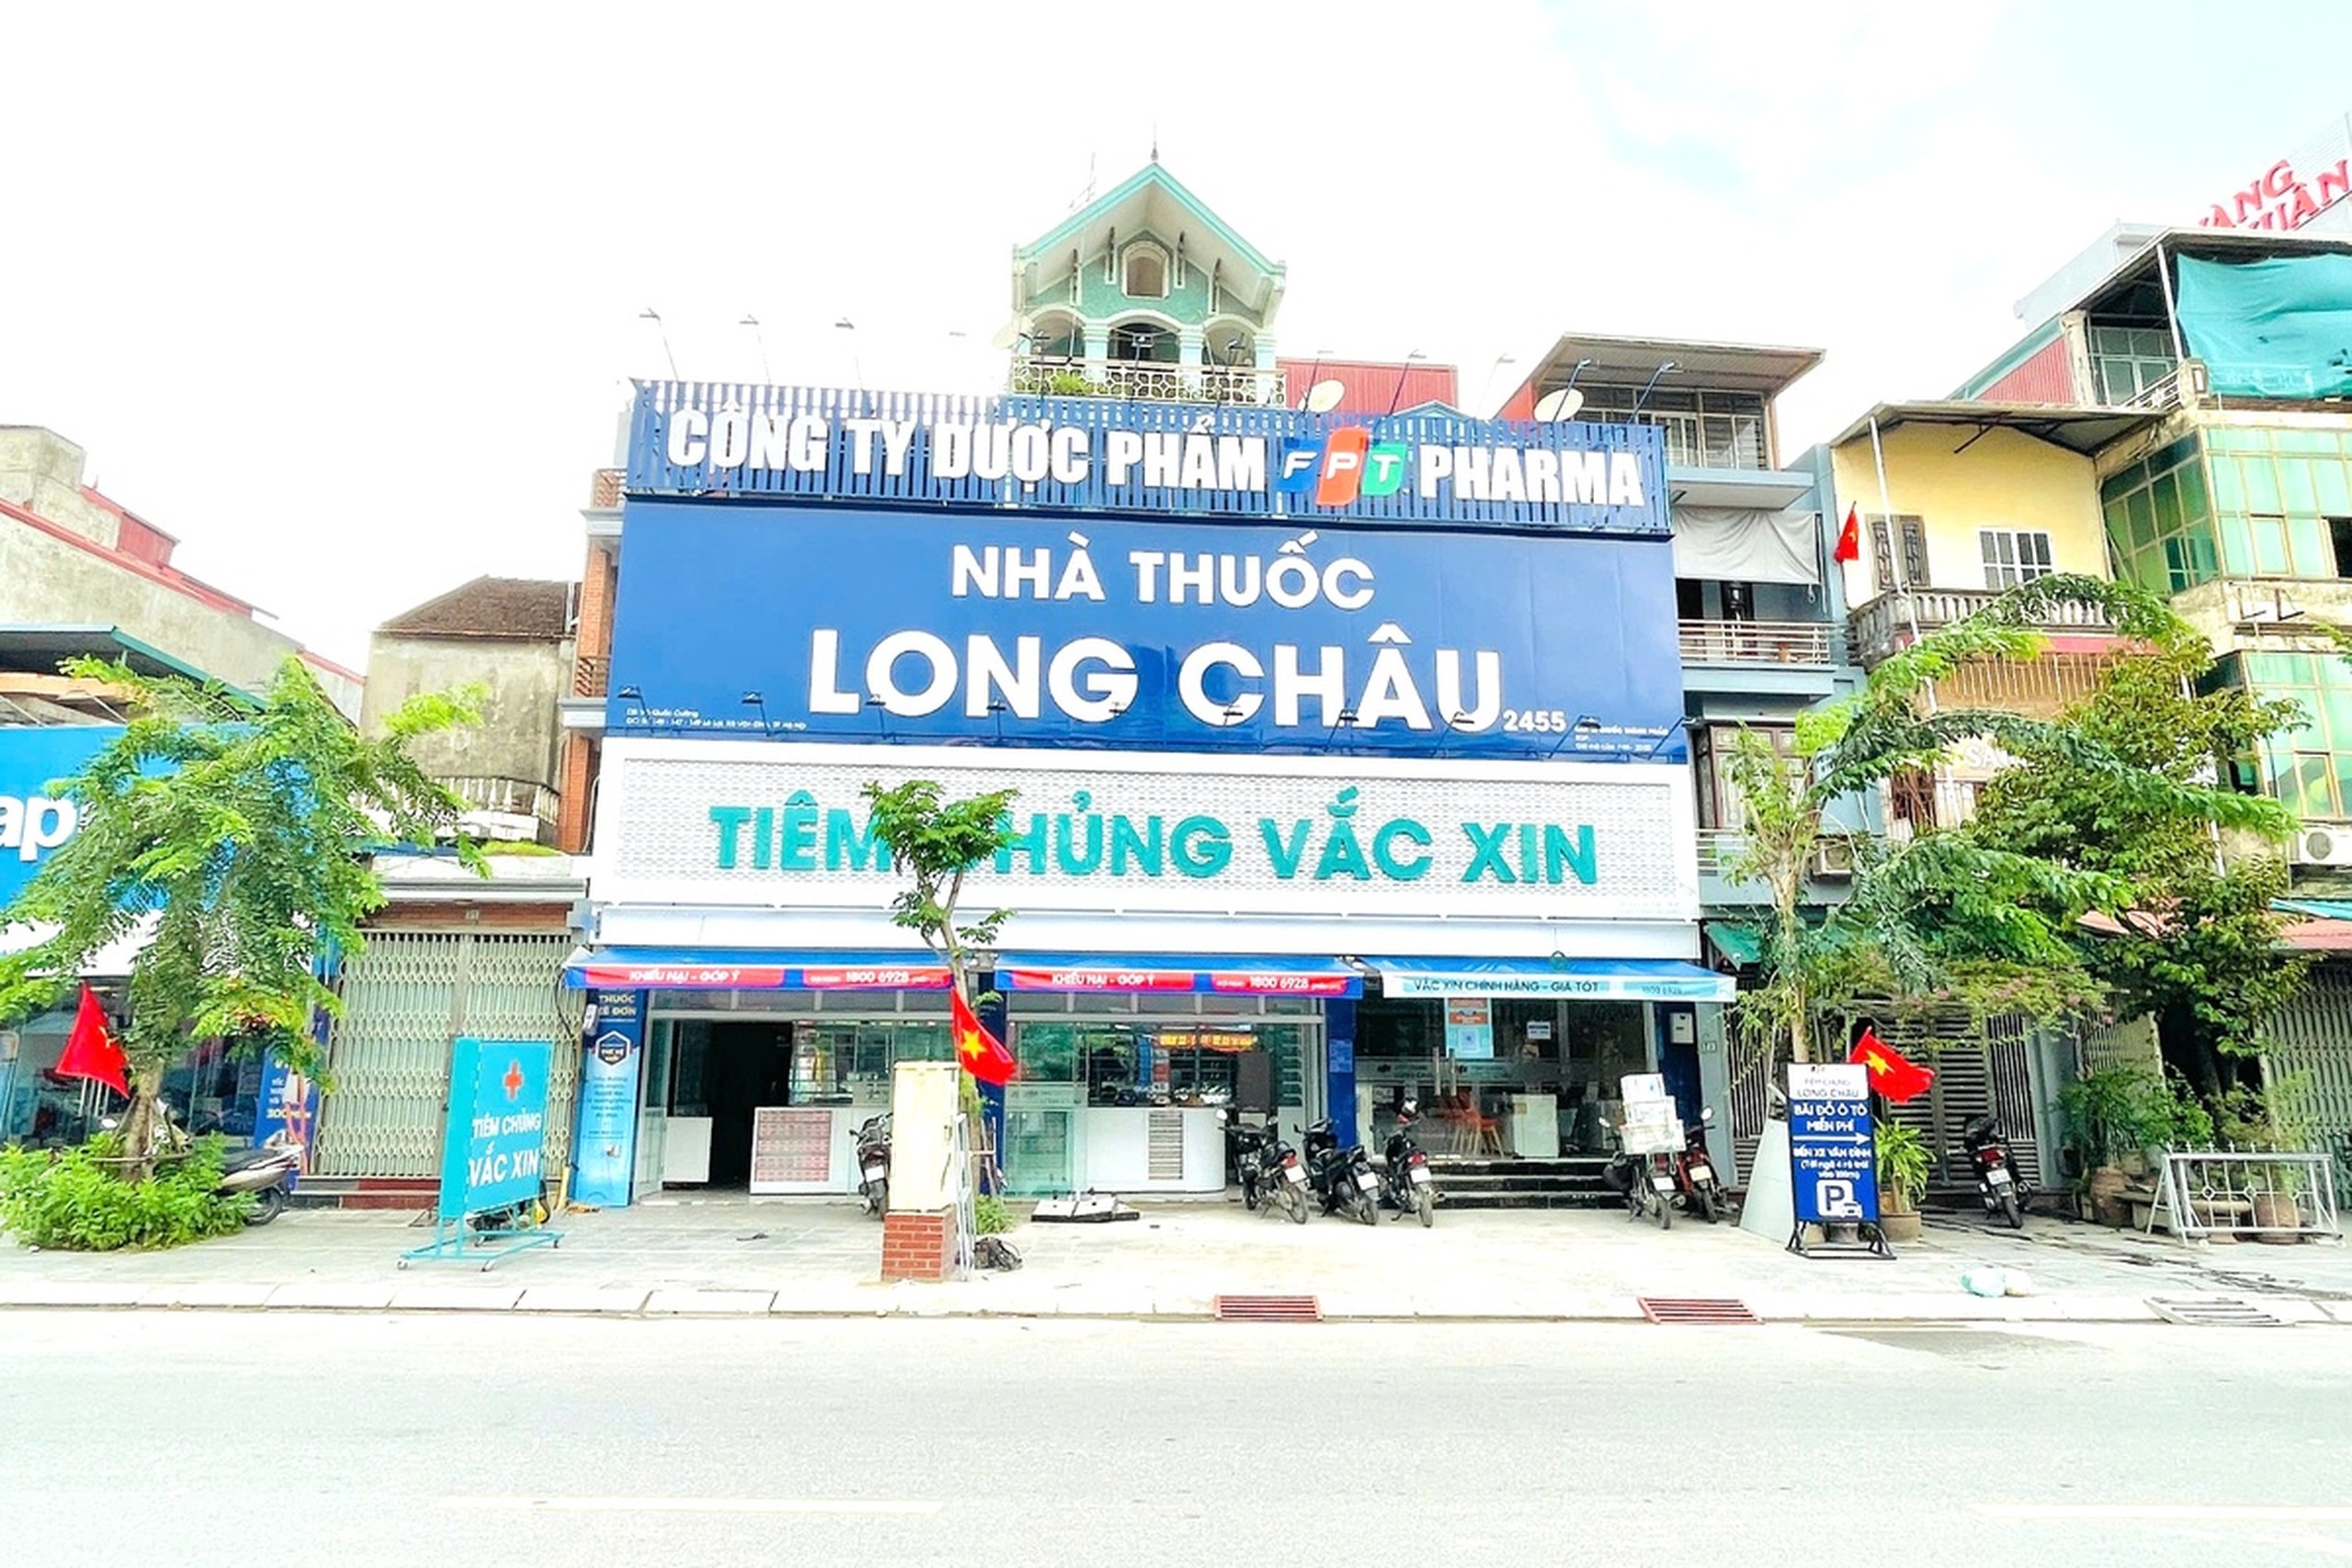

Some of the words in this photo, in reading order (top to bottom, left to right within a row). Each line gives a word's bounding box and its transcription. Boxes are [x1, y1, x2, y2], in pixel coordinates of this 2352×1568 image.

[667, 400, 829, 469] CÔNG
[843, 417, 916, 476] TY
[933, 412, 1091, 492] DƯỢC
[1107, 412, 1266, 492] PHẨM
[1419, 444, 1645, 508] PHARMA
[952, 530, 1106, 602] NHÀ
[1128, 529, 1375, 611] THUỐC
[808, 628, 1139, 724] LONG
[1177, 623, 1503, 733] CHÂU
[1502, 709, 1567, 734] 2455
[708, 789, 891, 873] TIÊM
[946, 790, 1234, 879] HỦNG
[1258, 784, 1433, 881] VẮC
[1461, 822, 1598, 885] XIN
[845, 971, 874, 983] 1800
[877, 972, 910, 983] 6928
[1250, 976, 1278, 987] 1800
[1280, 977, 1309, 988] 6928
[472, 1111, 501, 1139] TIÊM
[502, 1107, 542, 1136] CHỦNG
[469, 1140, 508, 1188] VẮC
[511, 1148, 539, 1179] XIN
[1825, 1186, 1845, 1211] P
